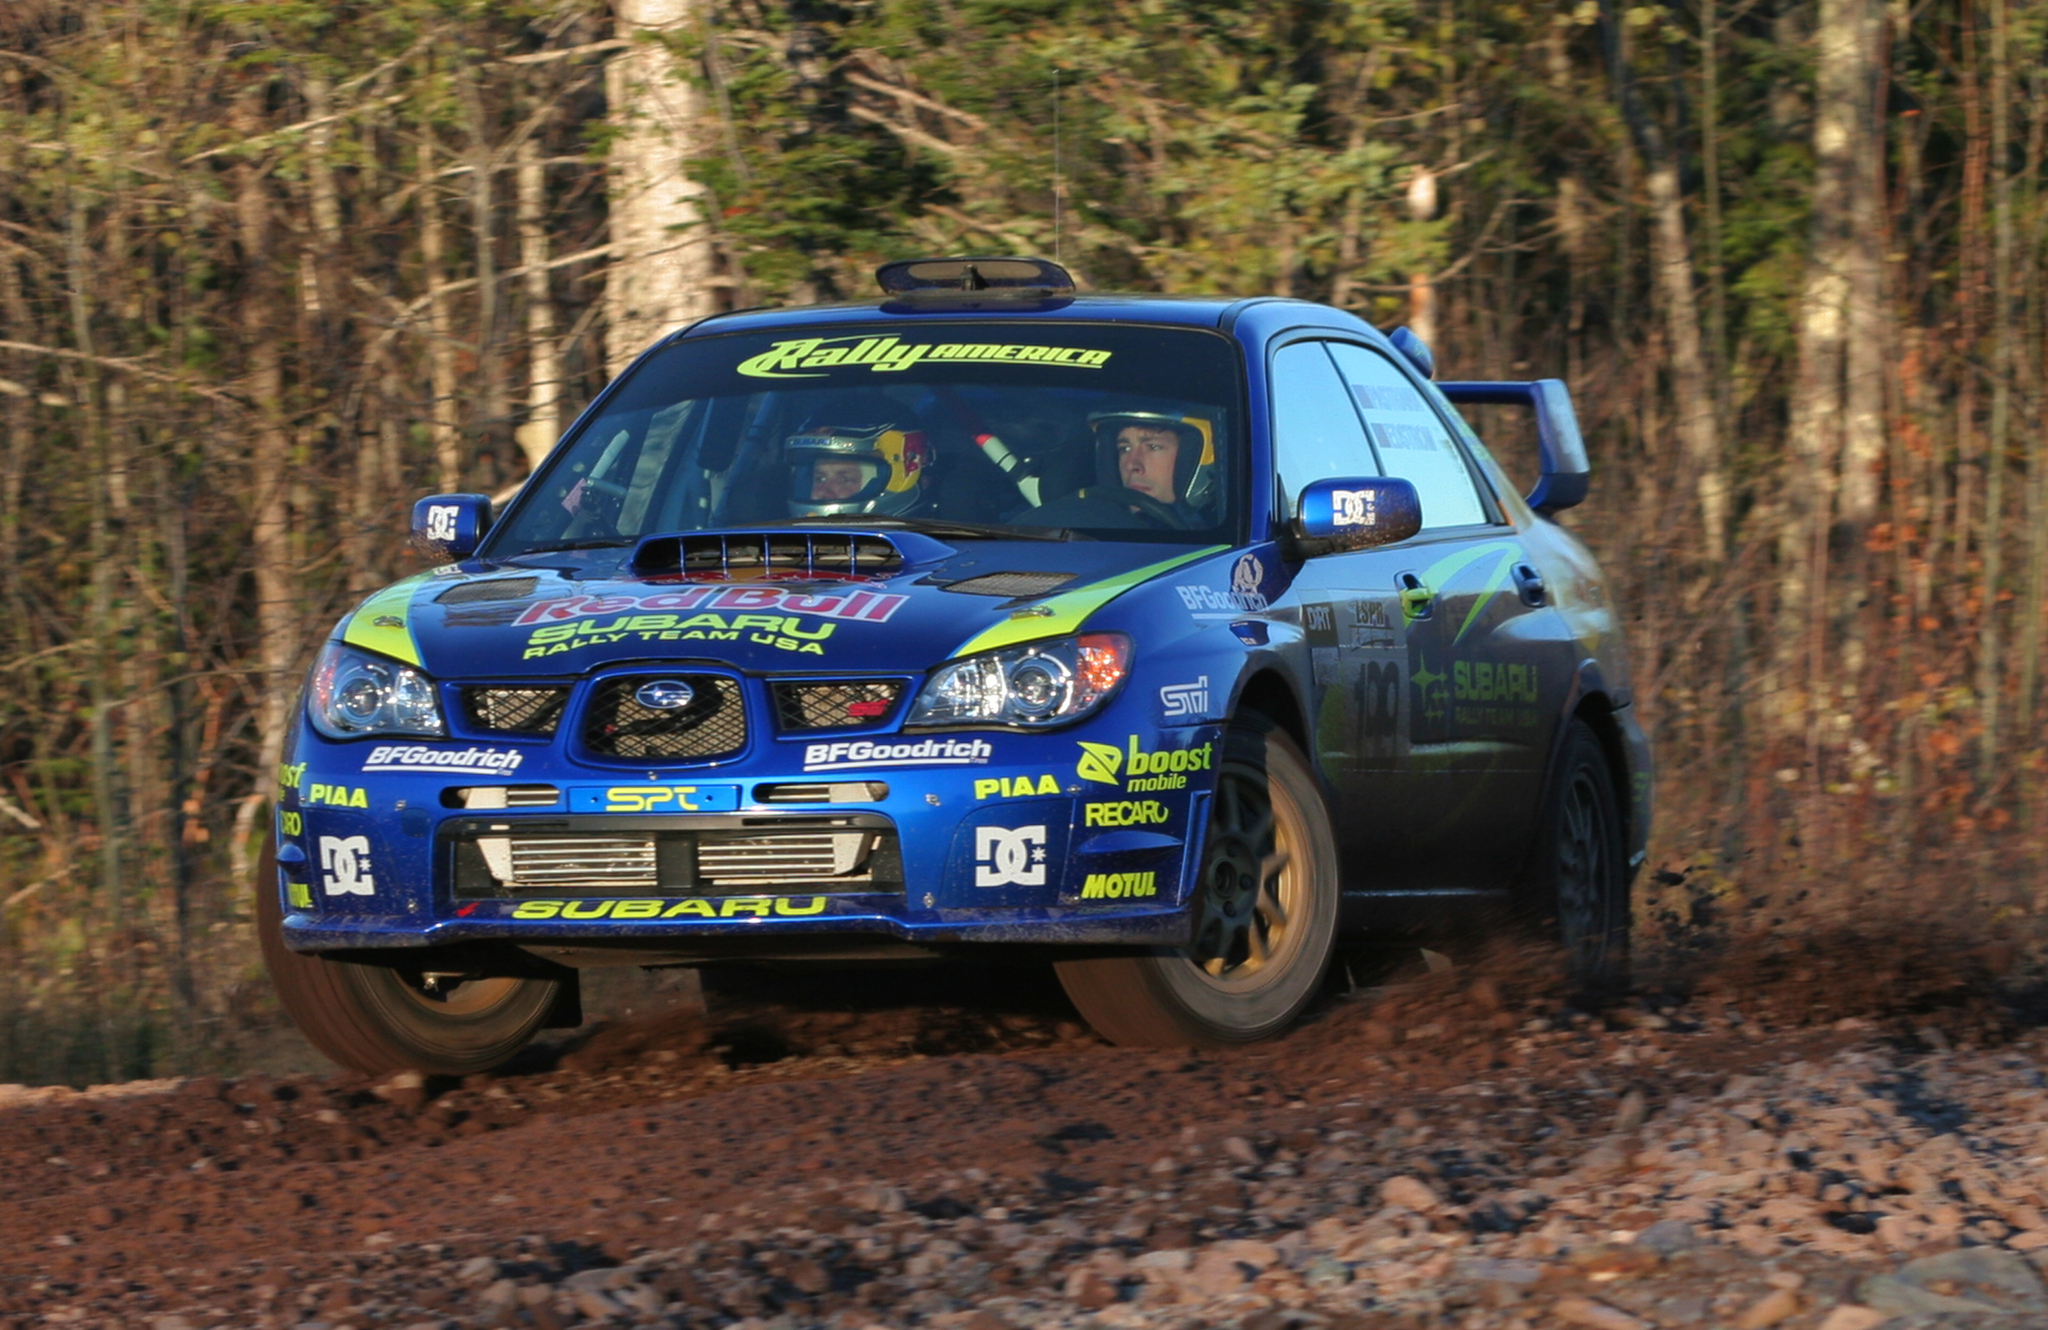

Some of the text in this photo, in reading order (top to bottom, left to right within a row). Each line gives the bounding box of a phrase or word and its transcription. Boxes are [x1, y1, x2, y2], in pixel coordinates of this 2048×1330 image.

[737, 336, 1112, 376] Rally AMERICA
[510, 586, 911, 627] Red Bull
[528, 613, 837, 645] SUBARU
[523, 630, 824, 660] RALLY TEAM USA
[1453, 660, 1538, 702] SUBARU
[365, 746, 523, 769] BFGoodrich
[804, 739, 992, 764] BFGoodrich
[1126, 734, 1212, 775] boost
[310, 783, 368, 809] PIAA
[973, 775, 1061, 800] PIAA
[1127, 773, 1187, 792] mobile
[1085, 800, 1169, 827] RECARO
[1081, 872, 1157, 899] MOTUL
[512, 896, 827, 919] SUBARU
